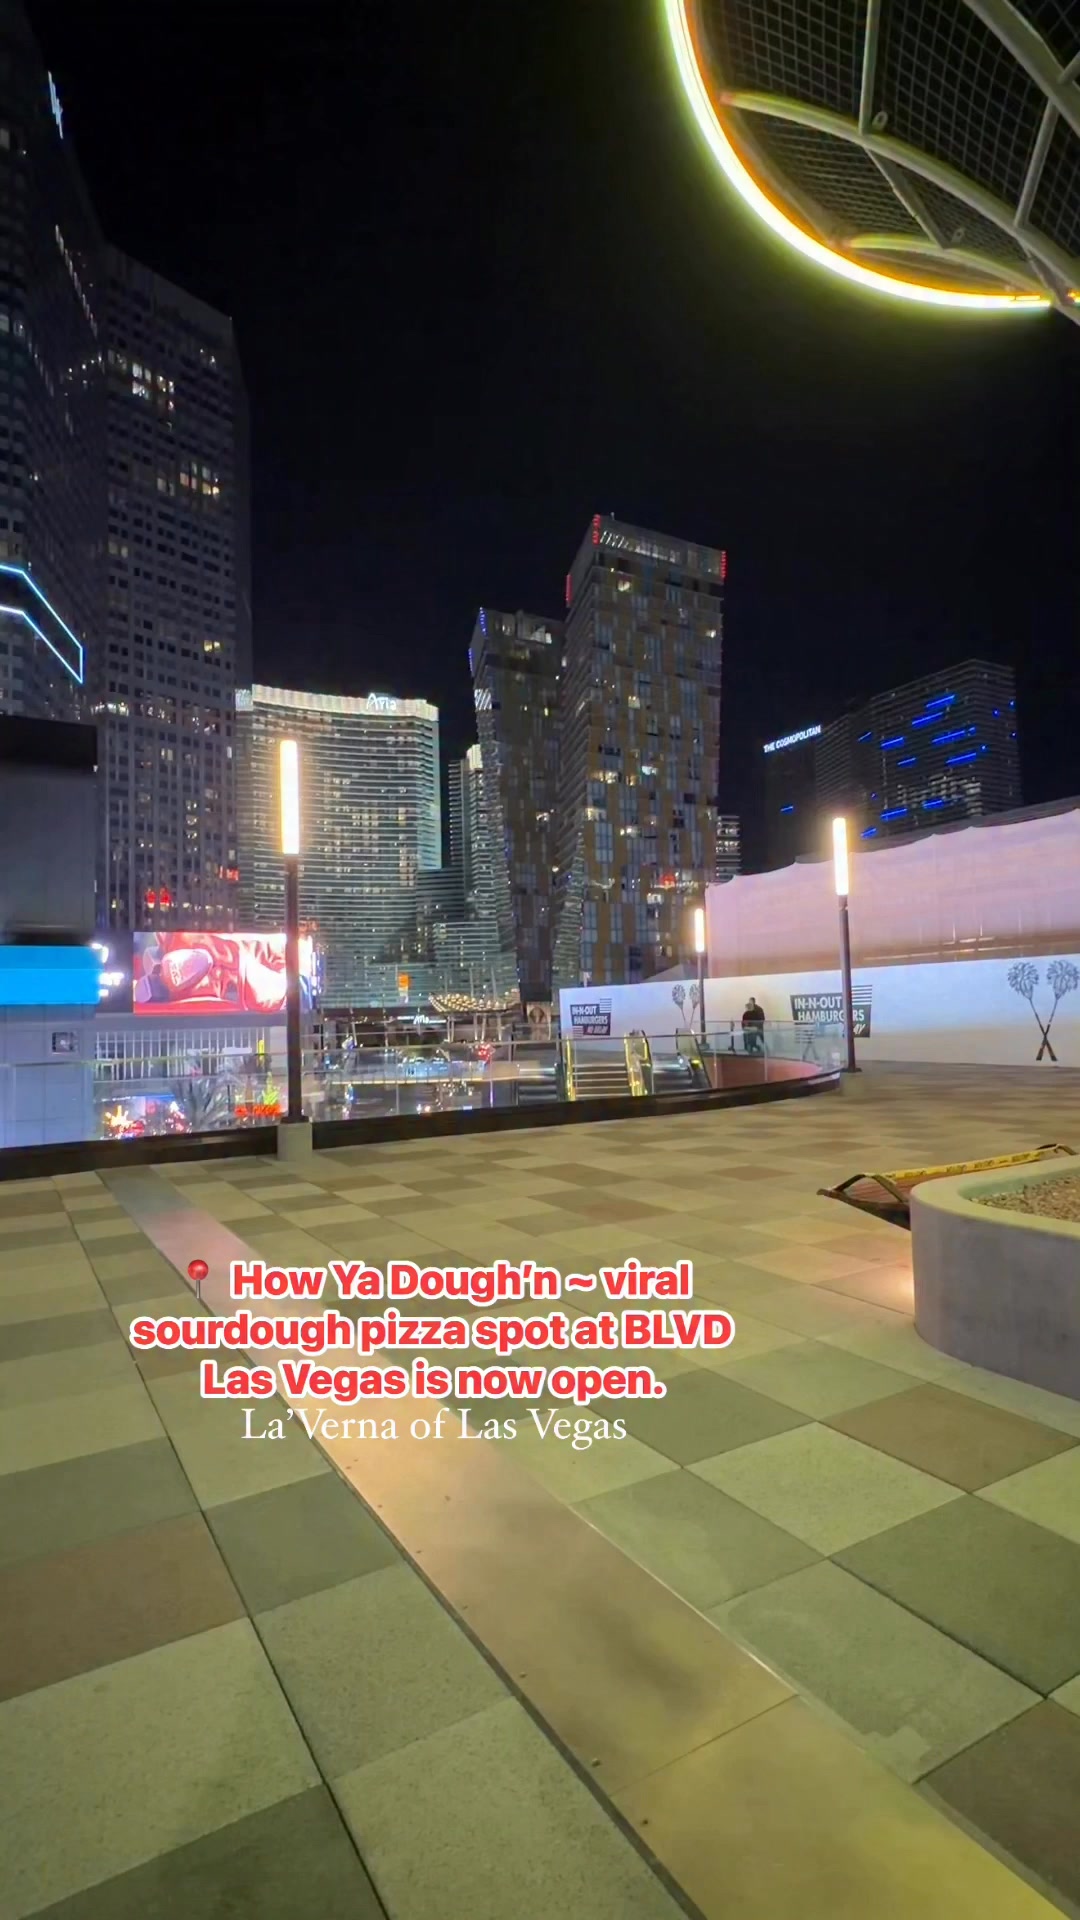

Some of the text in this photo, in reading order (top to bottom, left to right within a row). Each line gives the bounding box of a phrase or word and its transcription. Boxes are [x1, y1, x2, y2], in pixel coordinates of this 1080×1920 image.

[763, 725, 821, 753] THE COSMOPOLITAN
[794, 996, 842, 1009] IN-N-OUT
